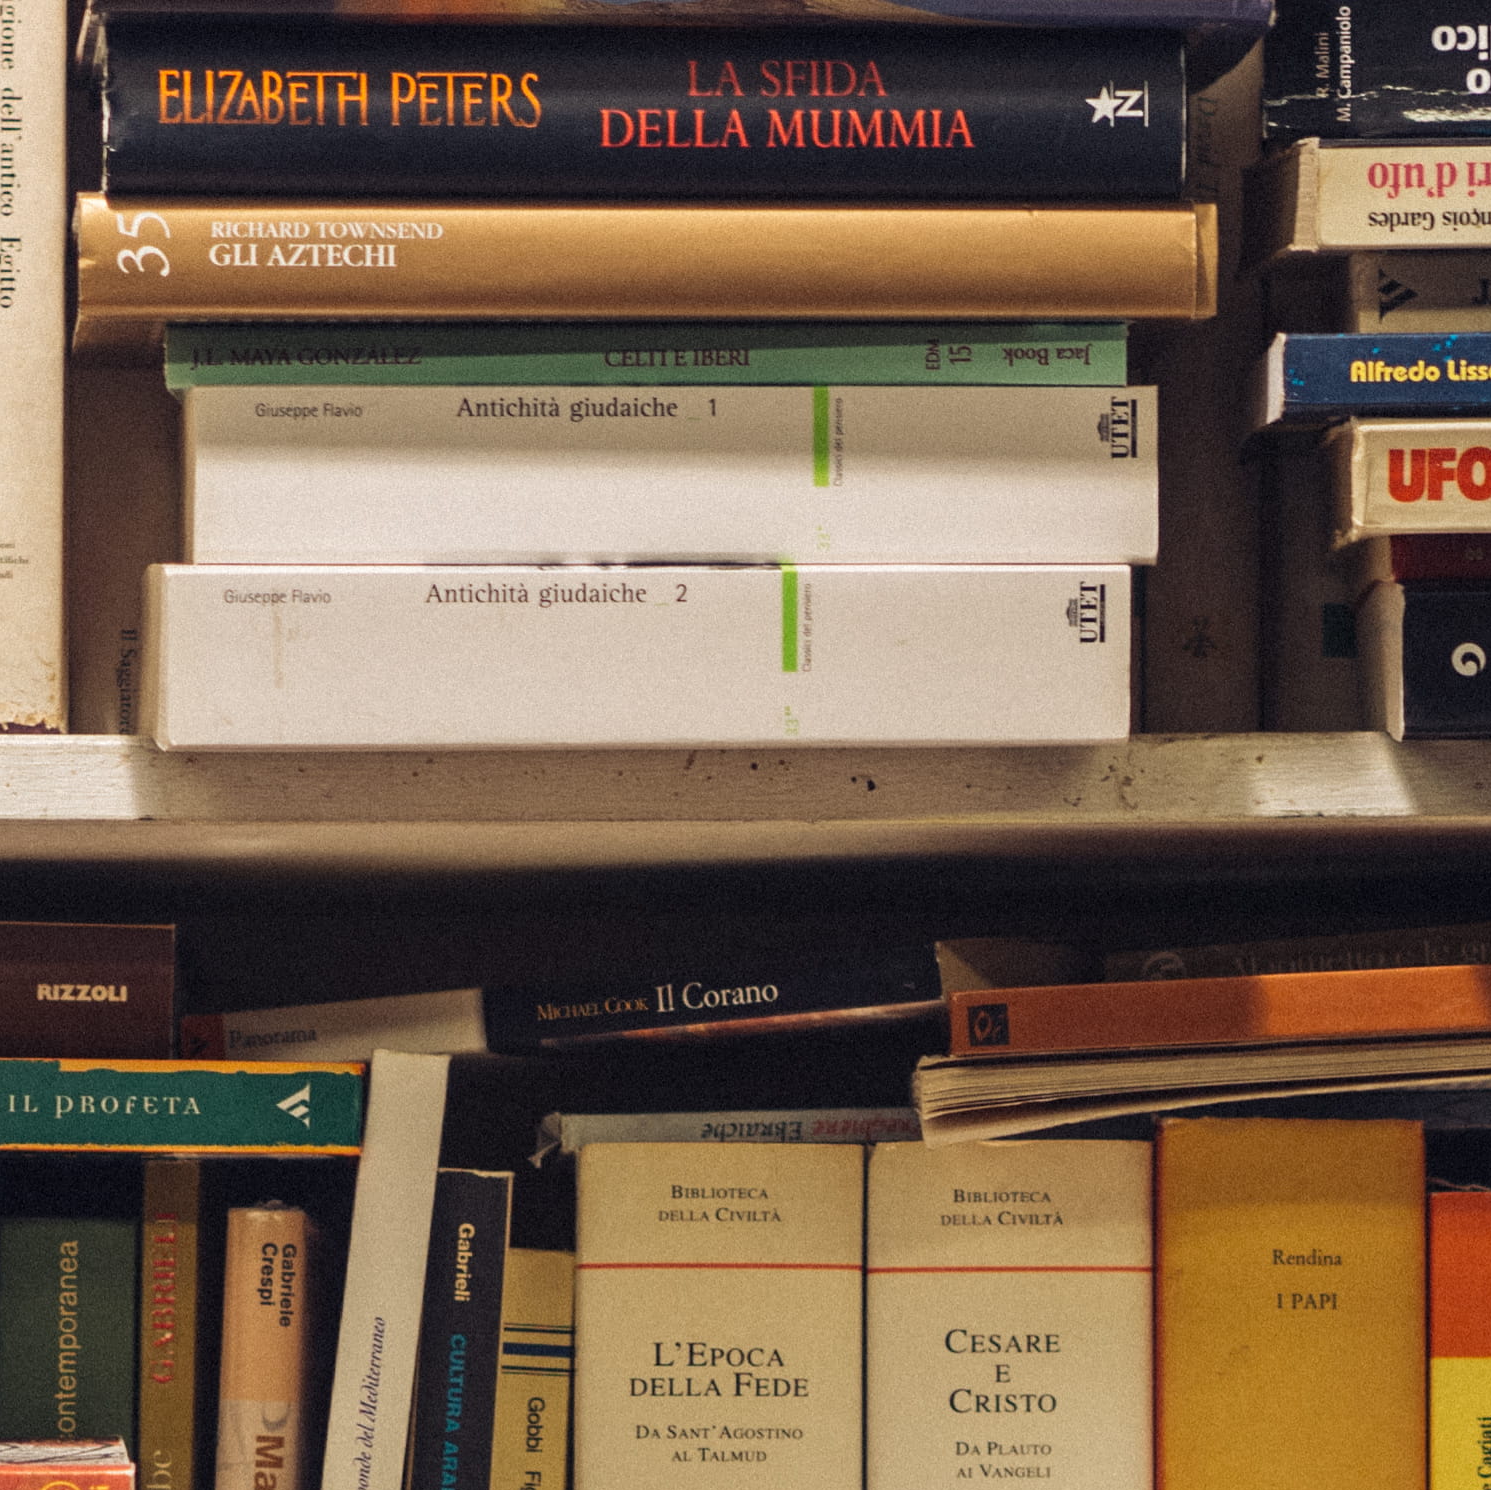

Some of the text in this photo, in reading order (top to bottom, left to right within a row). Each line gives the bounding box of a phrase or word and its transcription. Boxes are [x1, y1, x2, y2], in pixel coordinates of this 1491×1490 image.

[688, 61, 888, 99] LA SFIDA
[160, 70, 541, 127] ELIZABETH PETERS
[601, 109, 972, 147] DELLA MUMMIA
[1368, 163, 1457, 198] d'ufo
[211, 221, 443, 239] RICHARD TOWNSEND
[1368, 212, 1435, 232] Gardes
[210, 244, 394, 267] GLI AZTECHI
[1351, 360, 1440, 382] Alfredo
[255, 403, 362, 420] Giuseppe Flavio
[457, 397, 717, 422] Antichità giudaiche 1
[1111, 395, 1129, 460] UTET
[37, 984, 127, 1002] RIZZOLI
[657, 983, 778, 1012] Il Corano
[9, 1095, 37, 1112] IL
[671, 1185, 768, 1199] BIBLIOTECA
[1273, 1249, 1343, 1266] Rendina
[258, 1243, 278, 1305] Crespi
[281, 1244, 297, 1326] Gabriele
[1277, 1293, 1337, 1310] I PAPI
[944, 1329, 1060, 1353] CESARE
[654, 1342, 784, 1367] L'EPOCA
[630, 1372, 808, 1397] DELLA FEDE
[995, 1364, 1010, 1383] E
[949, 1389, 1057, 1413] CRISTO
